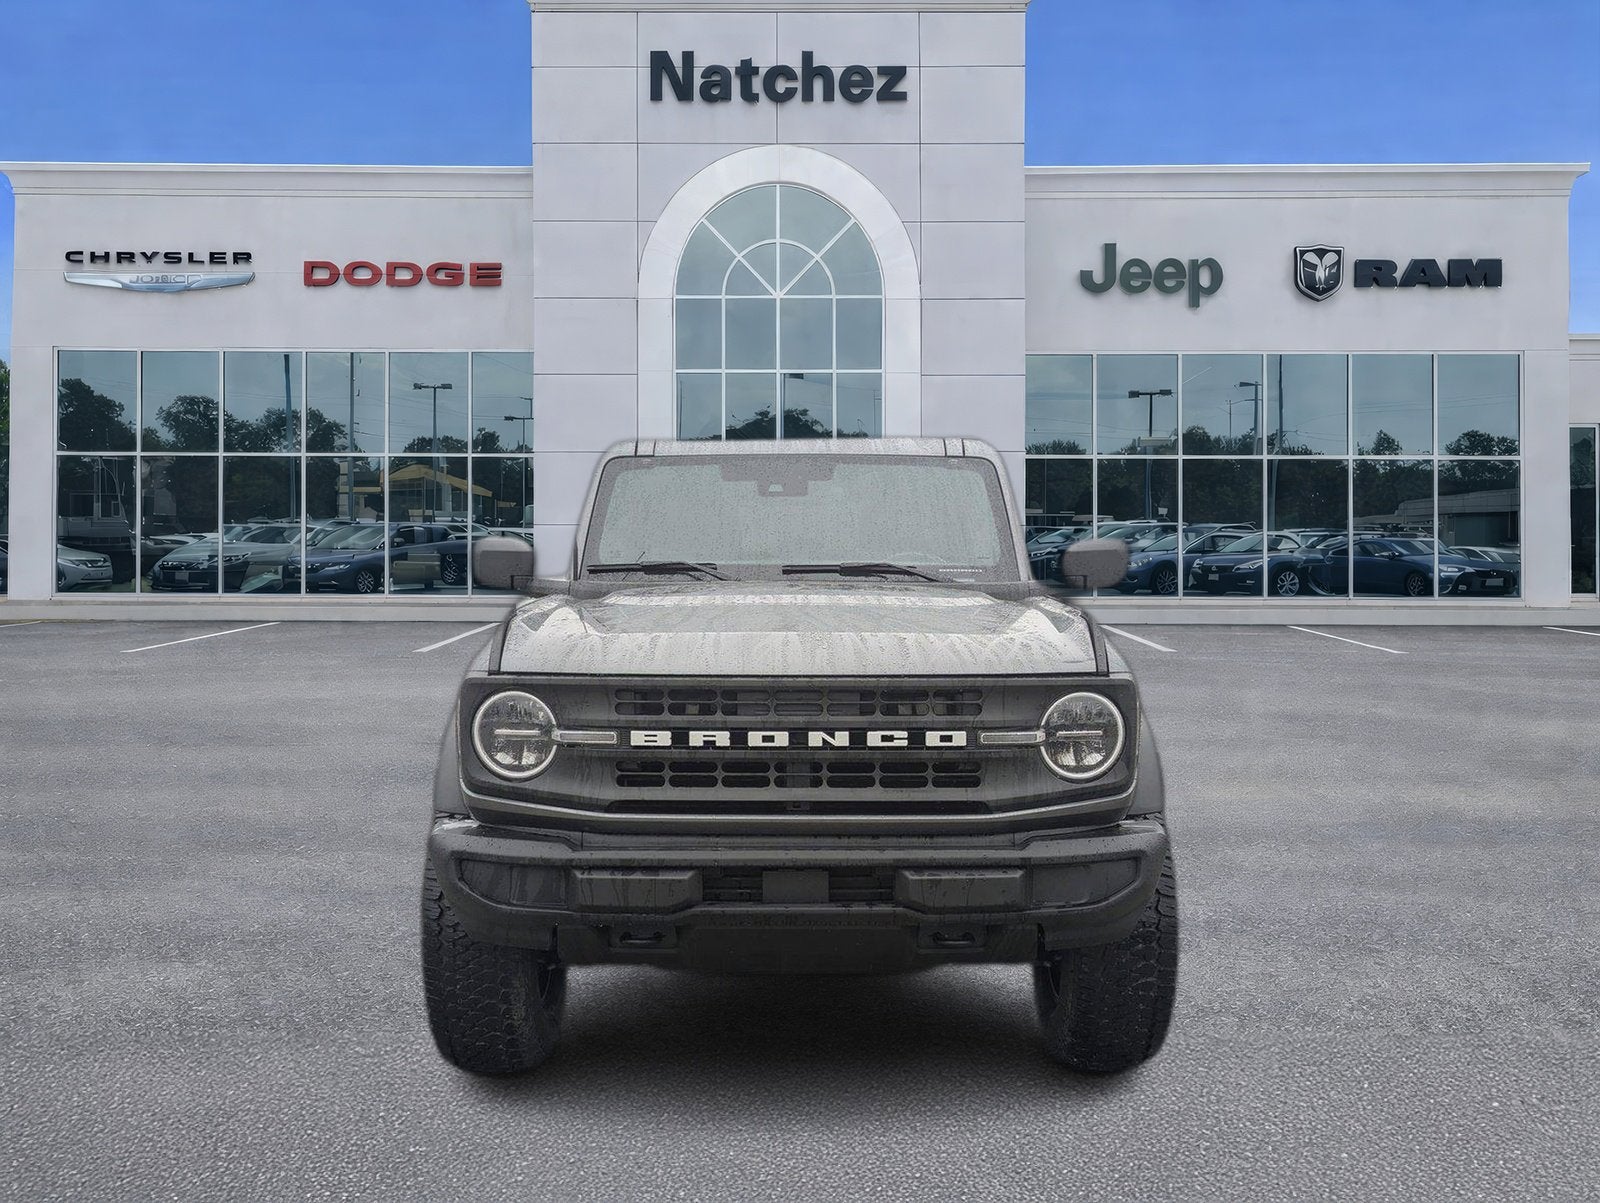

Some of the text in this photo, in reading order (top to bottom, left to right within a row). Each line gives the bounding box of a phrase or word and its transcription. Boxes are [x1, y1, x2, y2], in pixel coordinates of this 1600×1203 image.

[650, 50, 907, 103] Natchez
[65, 250, 252, 264] CHRYSLER
[303, 260, 502, 287] DODGE
[1080, 243, 1223, 308] Jeep
[1354, 258, 1503, 288] RAM
[629, 730, 967, 747] BRONCO
